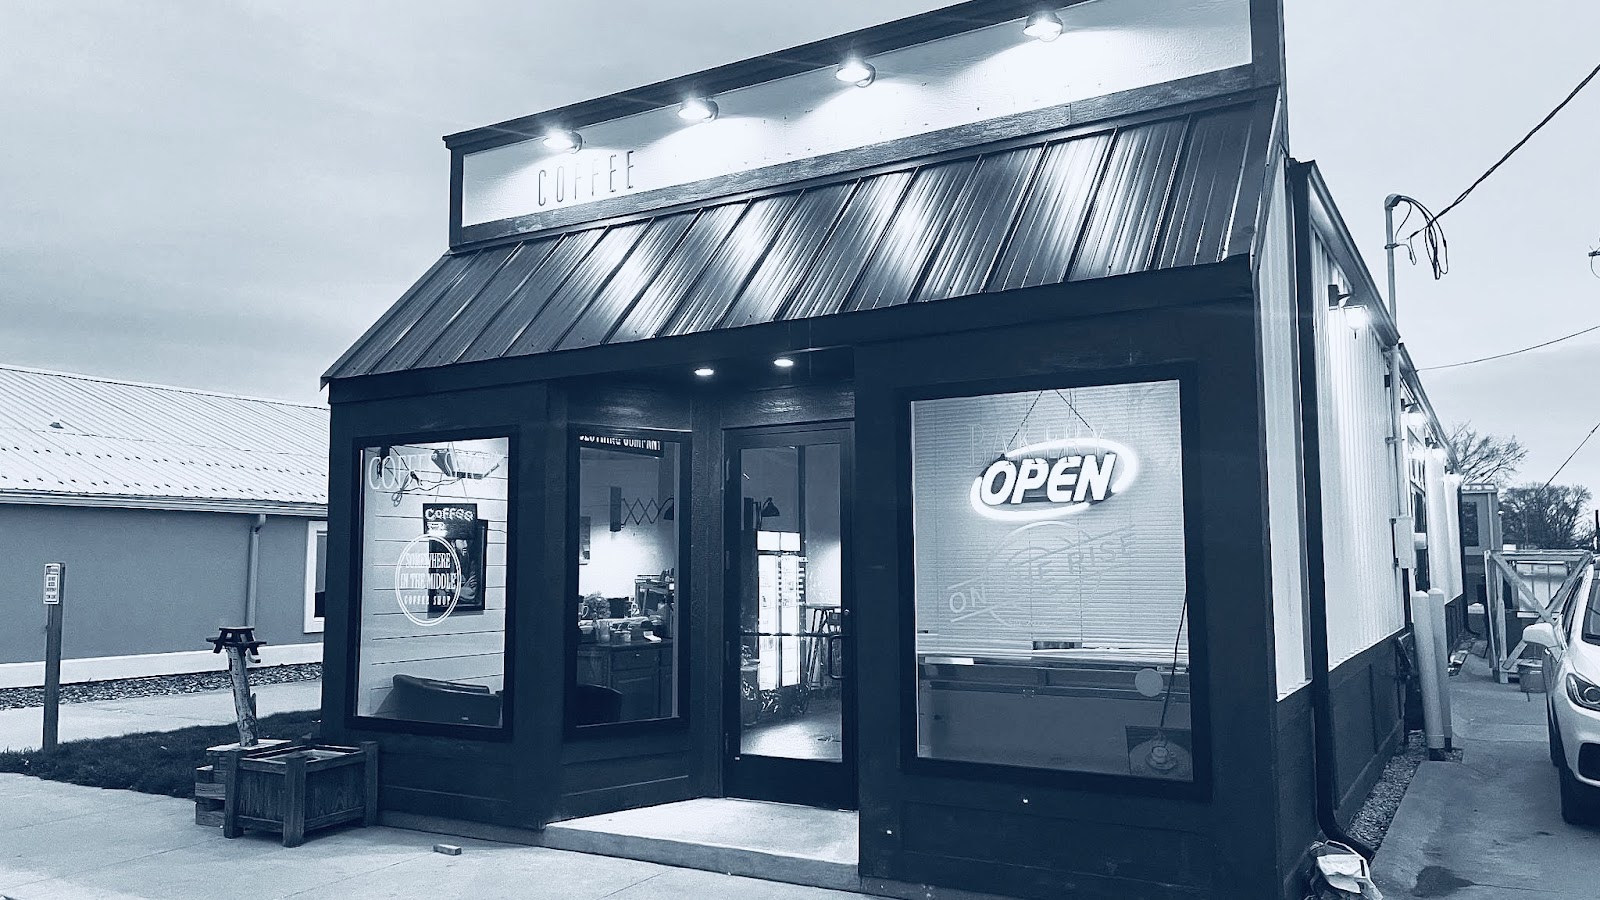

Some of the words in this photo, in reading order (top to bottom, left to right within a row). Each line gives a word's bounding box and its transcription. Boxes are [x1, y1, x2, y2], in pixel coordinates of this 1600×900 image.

[538, 150, 634, 207] COFFEE
[980, 452, 1117, 505] OPEN
[405, 552, 451, 569] SOMEWHERE
[949, 582, 987, 613] ON
[1068, 533, 1136, 574] RISE
[400, 572, 409, 589] IN
[410, 572, 426, 589] THE
[427, 572, 457, 590] MIDDLE
[404, 595, 430, 605] COFFEE
[433, 595, 451, 606] SHOP
